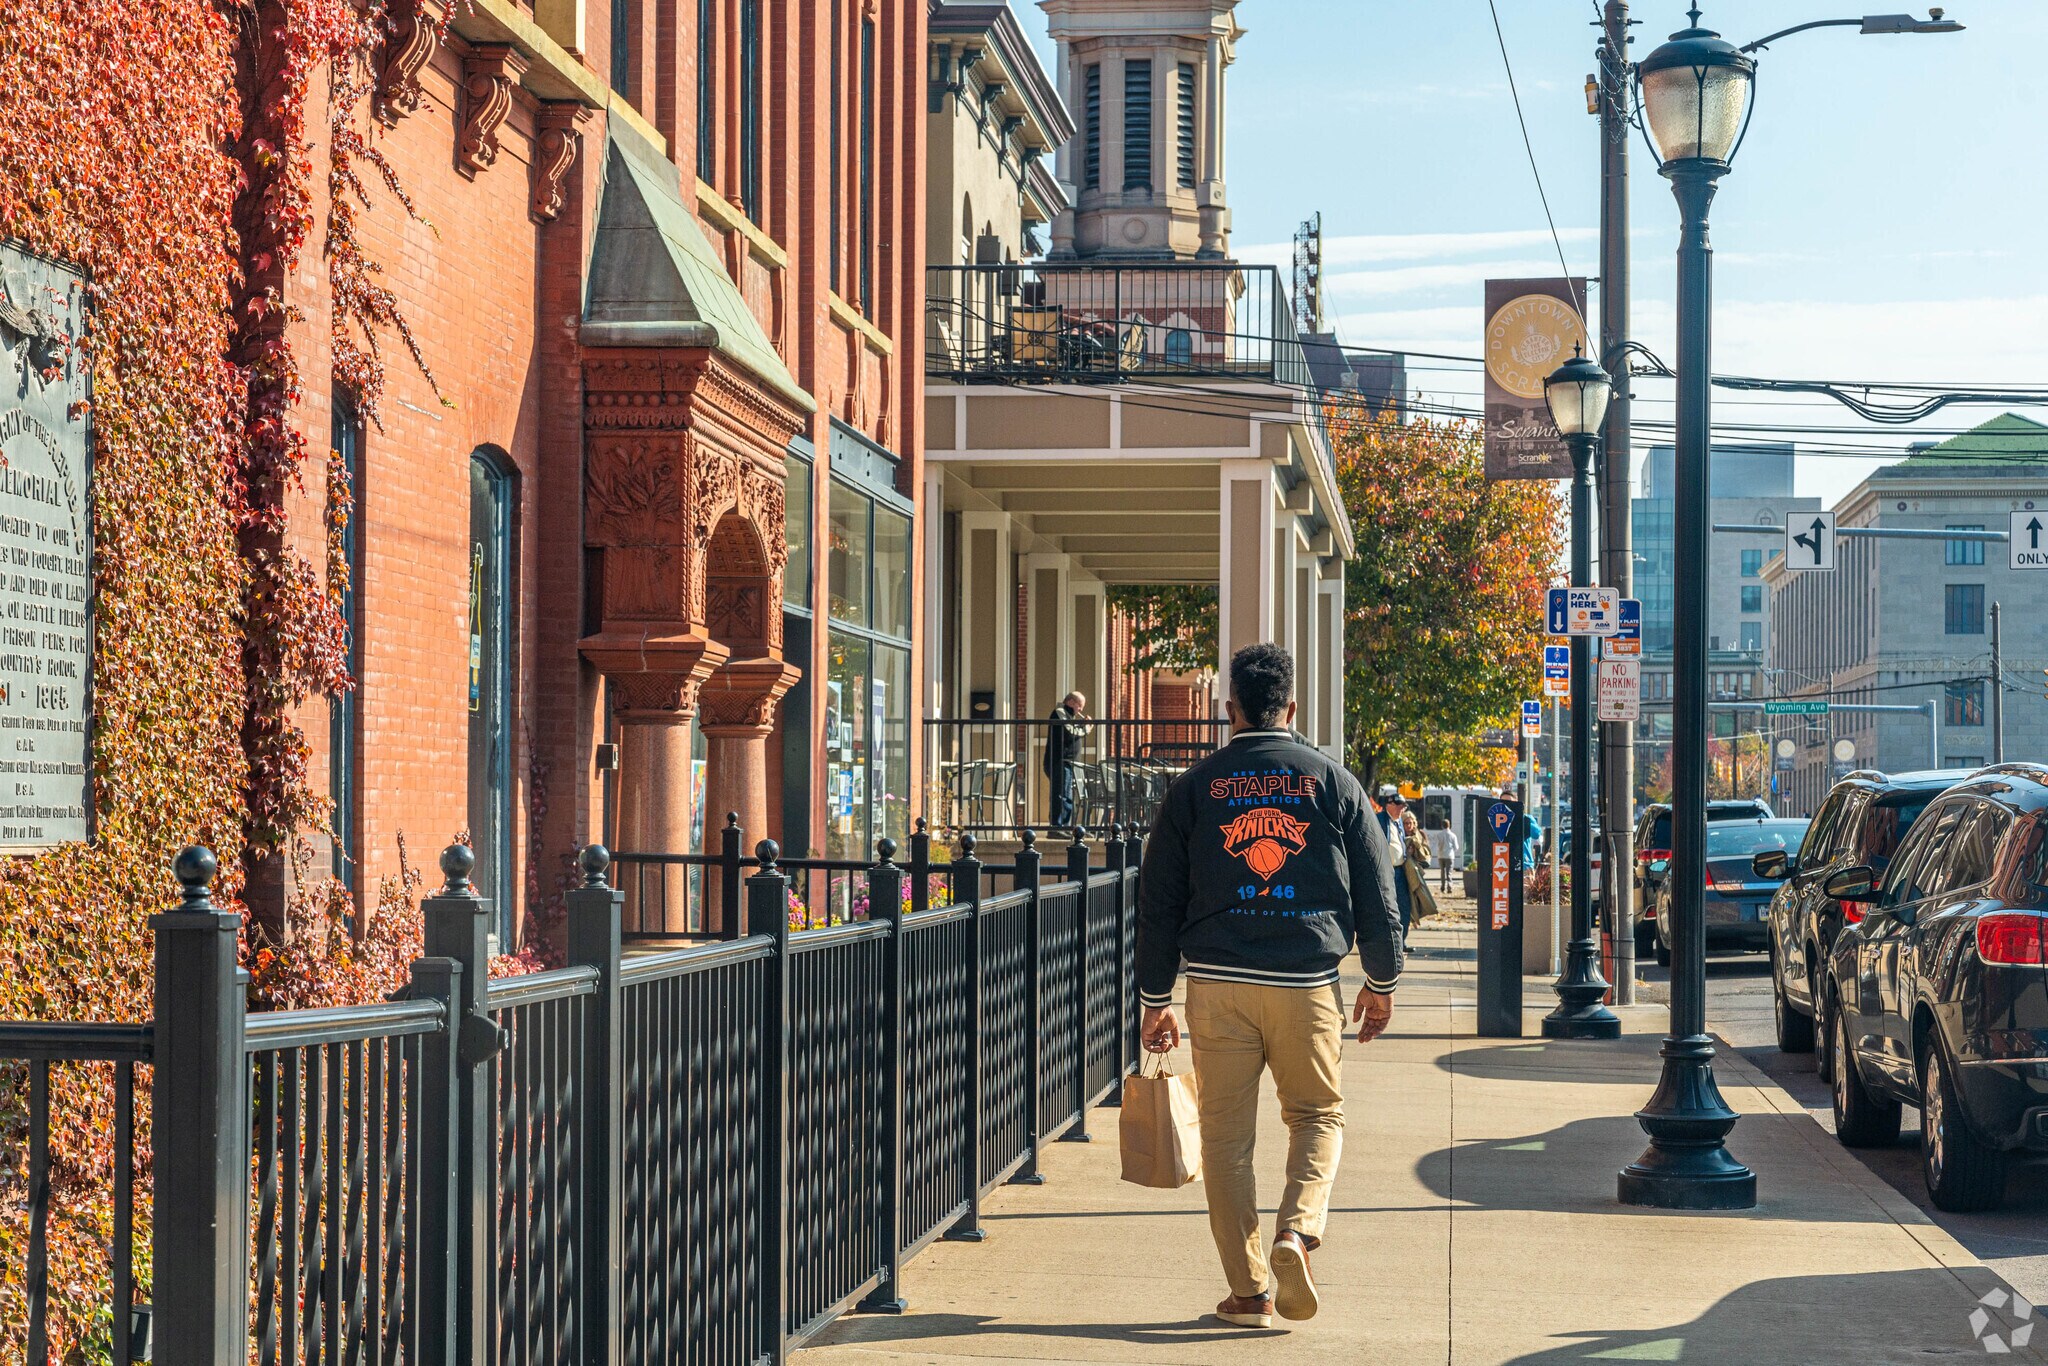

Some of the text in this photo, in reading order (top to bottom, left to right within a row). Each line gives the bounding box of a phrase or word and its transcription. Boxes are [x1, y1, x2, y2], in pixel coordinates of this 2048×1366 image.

[1491, 302, 1575, 350] DOWNTOWN
[0, 409, 21, 447] RMY
[36, 522, 47, 542] TO
[53, 527, 69, 547] OUR
[11, 546, 29, 567] WHO
[2017, 553, 2048, 565] ONLY
[10, 573, 26, 593] AND
[29, 576, 48, 597] DIED
[52, 581, 63, 600] ON
[66, 583, 86, 603] LAND
[1570, 593, 1590, 601] PAY
[1570, 600, 1597, 608] HERE
[8, 600, 19, 619] ON
[24, 602, 56, 624] BATTLE
[59, 608, 86, 629] FIELDS
[3, 626, 36, 648] PRISON
[69, 635, 86, 654] FOR
[1612, 664, 1627, 676] NO
[1602, 677, 1637, 689] PARKING
[1767, 703, 1826, 713] Wyoming Ave
[1233, 770, 1256, 778] NEW
[1210, 775, 1317, 799] STAPLE
[1228, 796, 1302, 807] ATHLETICS
[1249, 809, 1282, 818] NEW YORK
[1495, 813, 1508, 828] P
[1228, 815, 1304, 849] KNICKS
[1494, 845, 1508, 881] PAY
[1237, 884, 1295, 900] 19 46
[1229, 908, 1256, 916] APLE
[1493, 888, 1508, 929] HER
